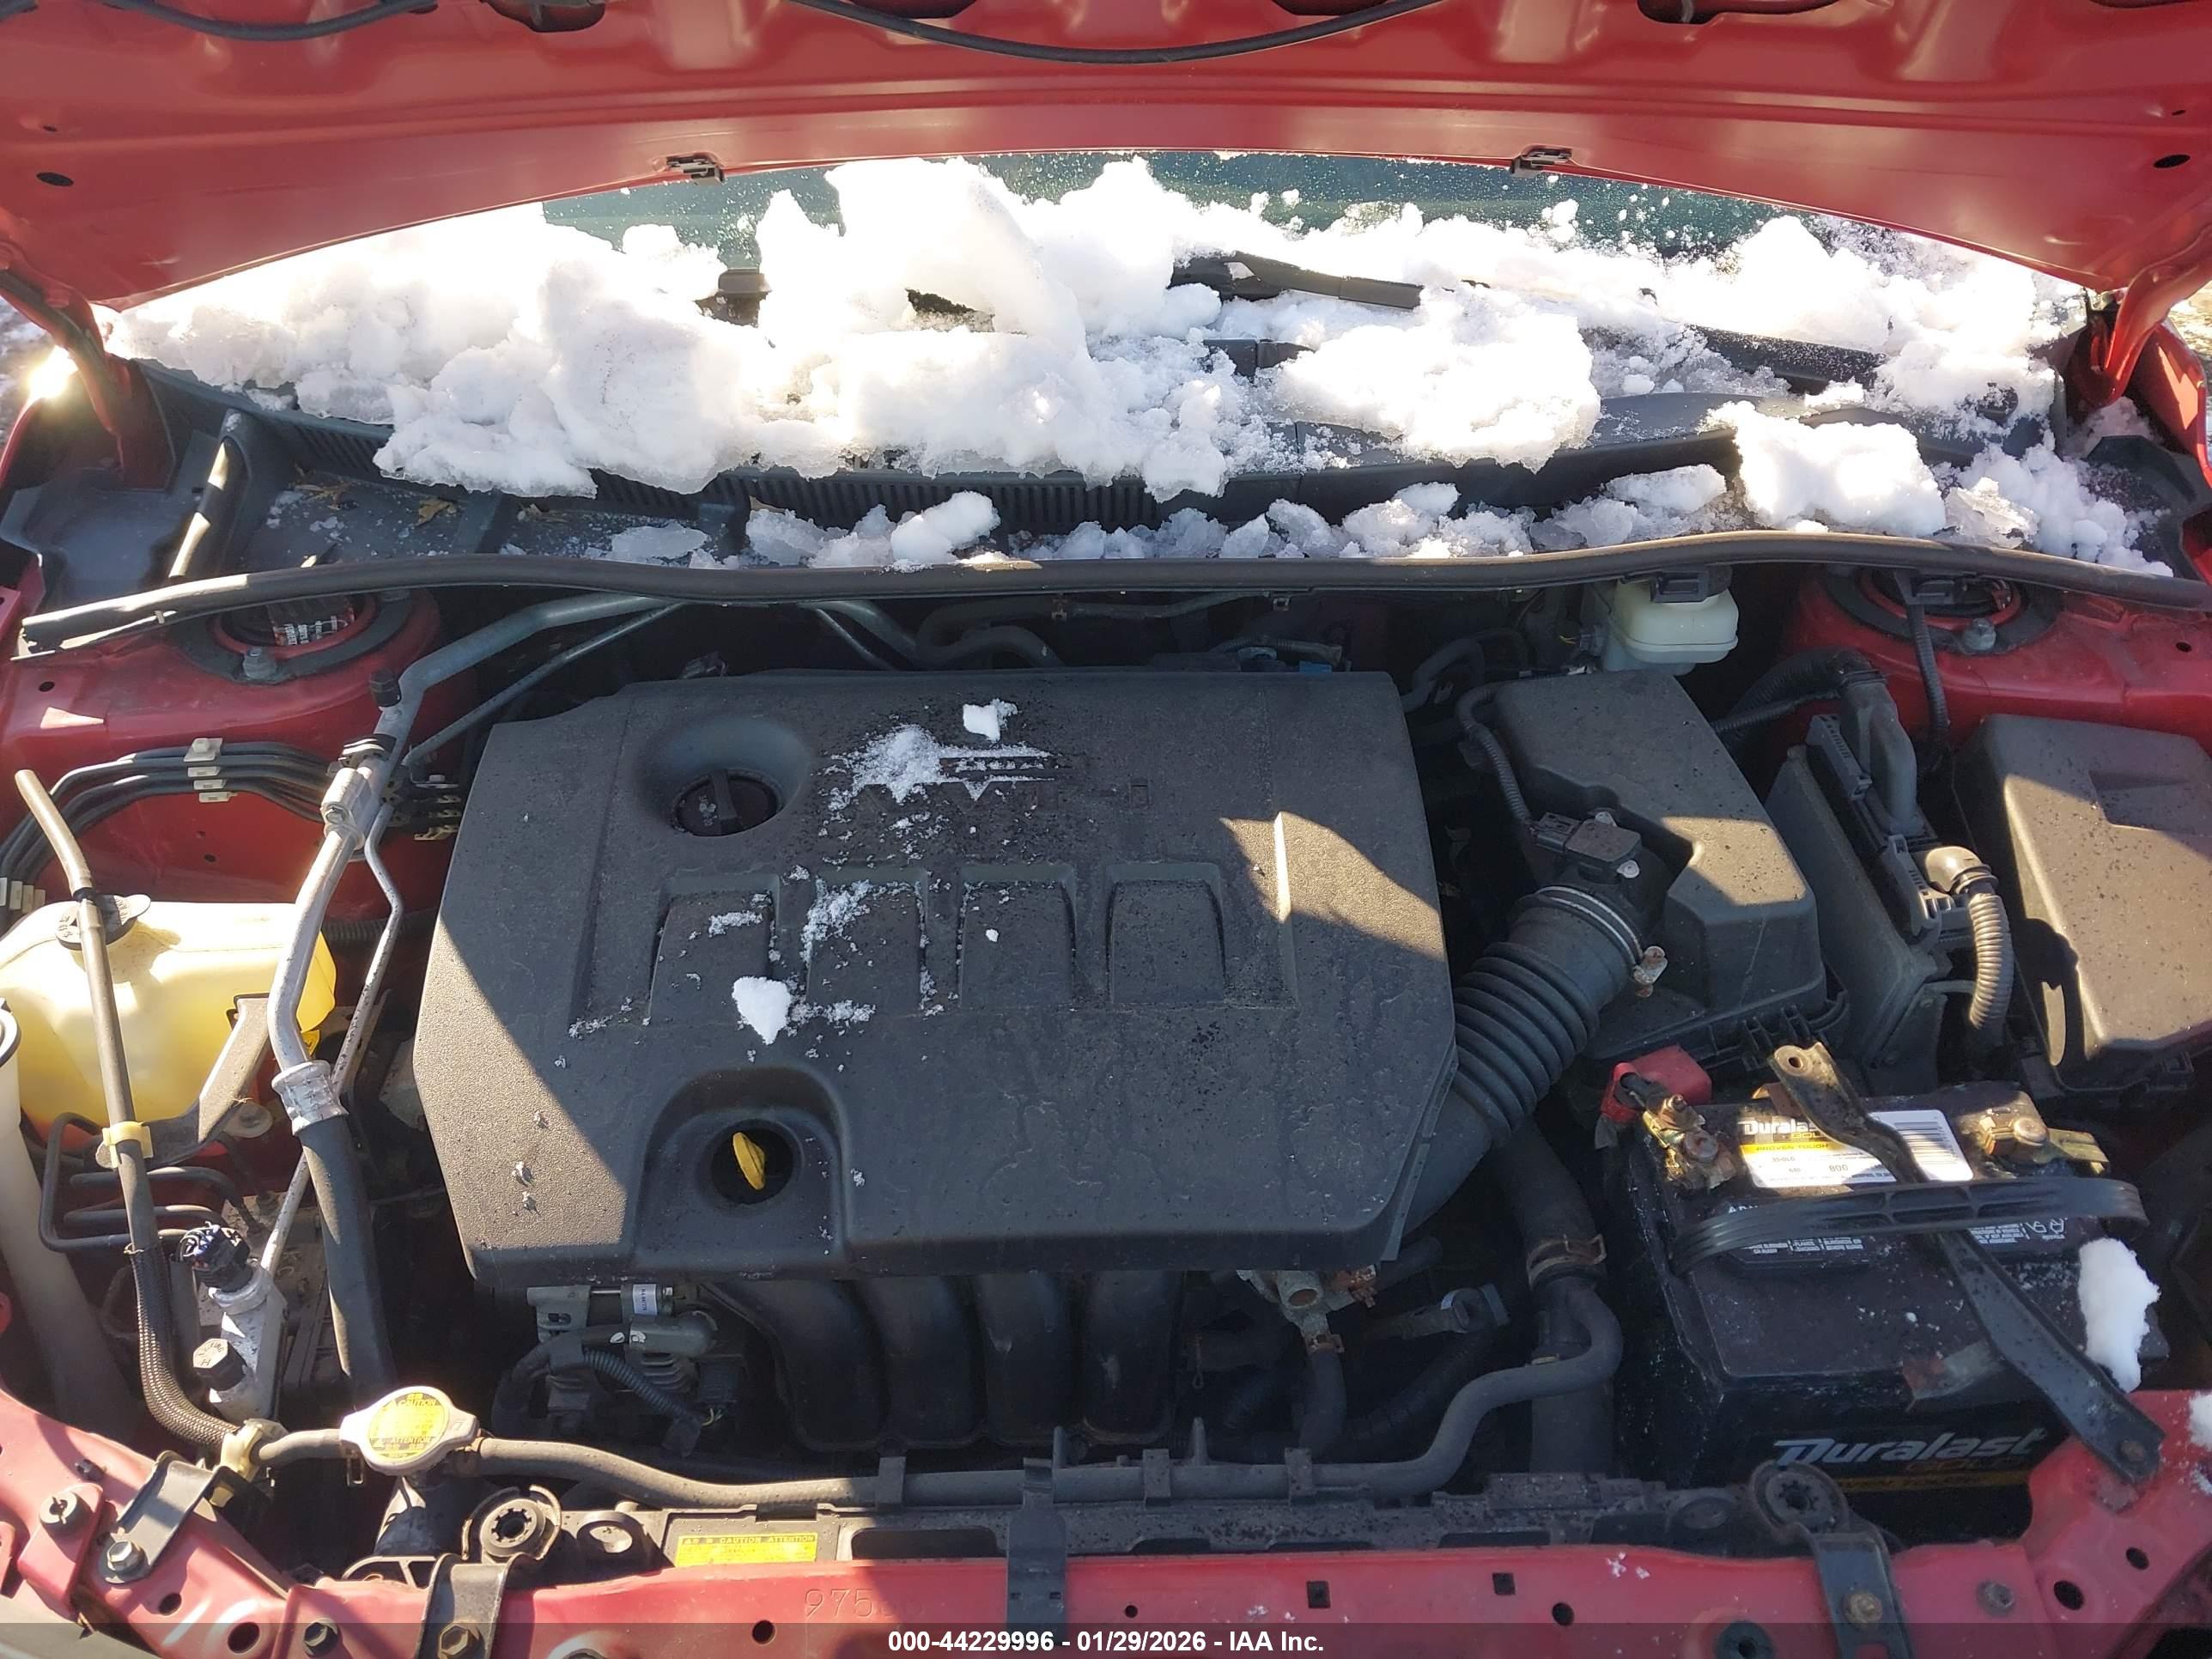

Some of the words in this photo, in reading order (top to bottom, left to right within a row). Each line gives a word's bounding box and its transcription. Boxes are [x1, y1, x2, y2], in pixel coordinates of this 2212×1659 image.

[1737, 1119, 1818, 1134] Duralas
[1829, 1164, 1849, 1173] 800
[1773, 1427, 2048, 1466] Duralast
[768, 1535, 814, 1544] ATTENTION
